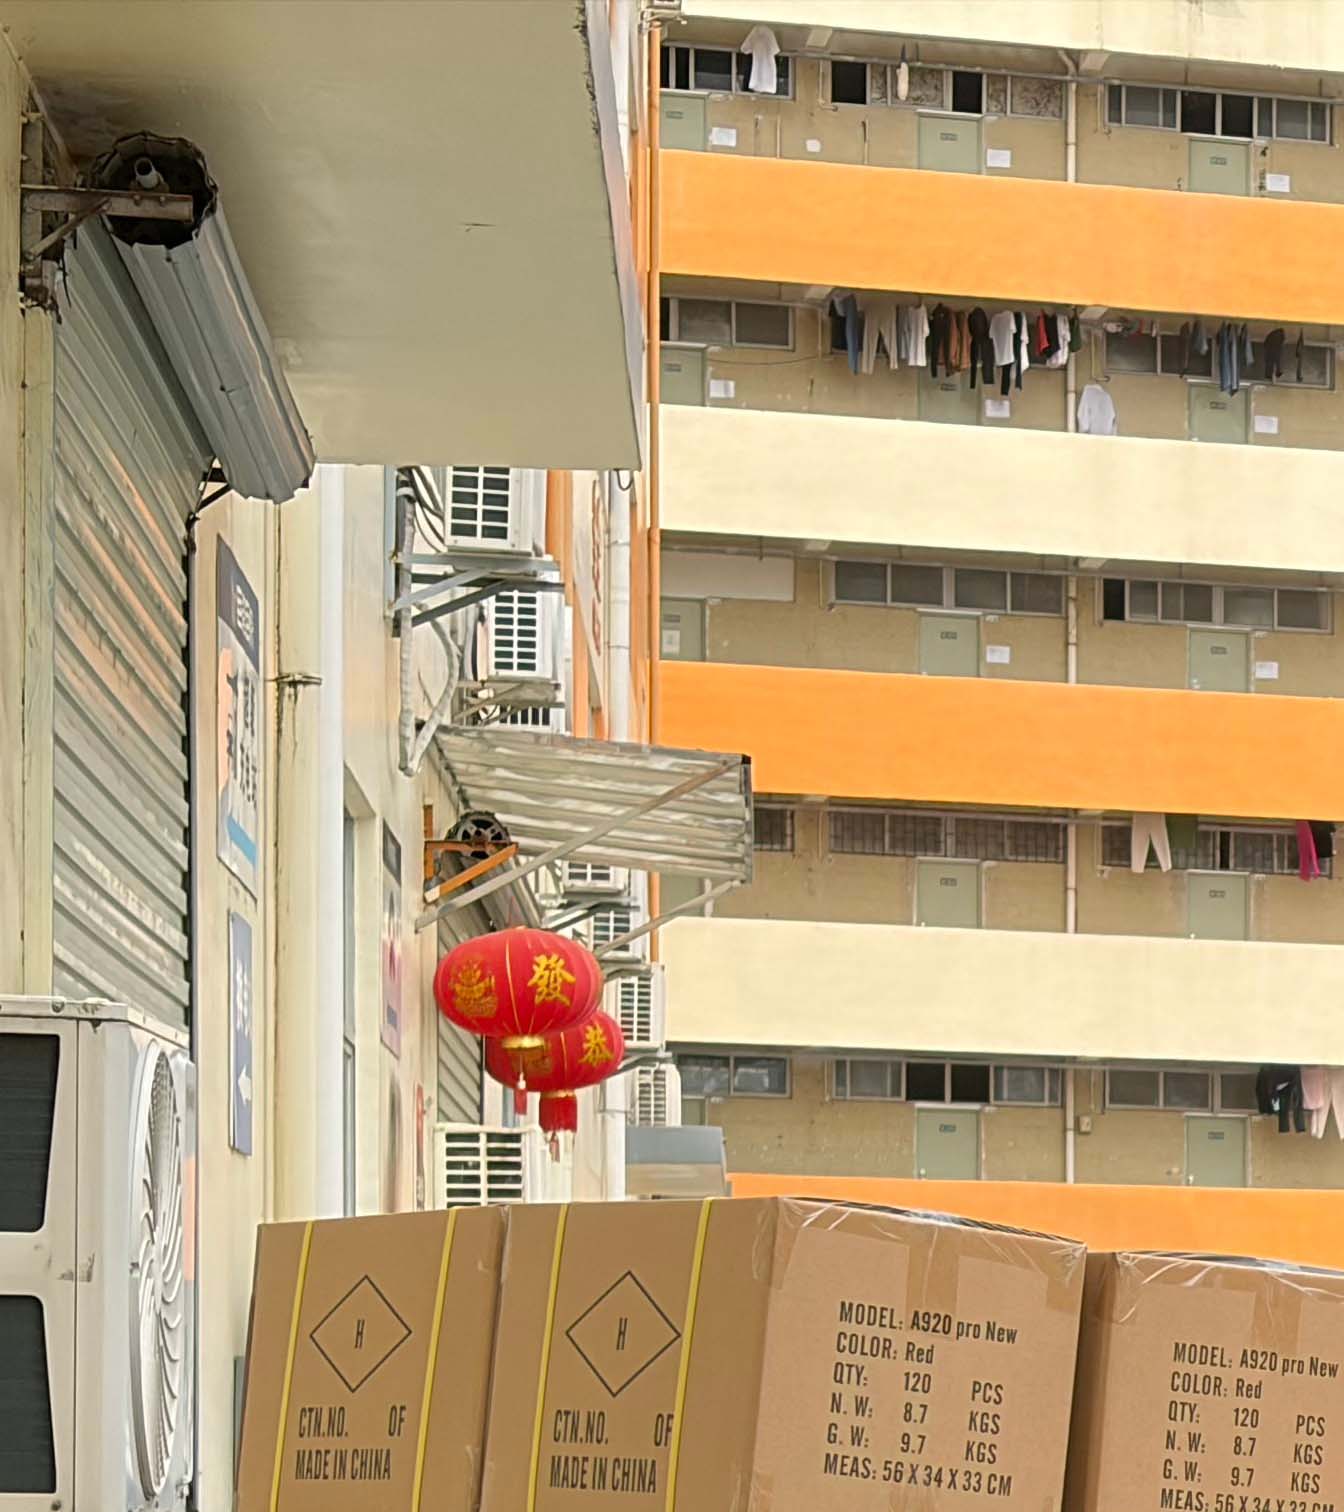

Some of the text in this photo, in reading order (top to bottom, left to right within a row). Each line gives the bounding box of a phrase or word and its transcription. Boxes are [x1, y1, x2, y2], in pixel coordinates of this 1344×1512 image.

[527, 953, 577, 1007] 發
[354, 1319, 365, 1349] H
[616, 1317, 628, 1350] H
[840, 1301, 1017, 1344] MODEL: A920 pro New
[837, 1332, 934, 1364] COLOR: Red
[834, 1362, 1003, 1405] QTY: 120 PCS
[299, 1405, 406, 1438] CTN.NO. OF
[554, 1409, 674, 1447] CTN.NO. OF
[904, 1402, 928, 1424] 8.7
[969, 1411, 1000, 1435] KGS
[295, 1449, 390, 1480] MADE IN CHINA
[901, 1433, 926, 1454] 9.7
[965, 1440, 997, 1464] KGS
[550, 1455, 656, 1493] MADE IN CHINA
[824, 1453, 1012, 1496] MEAS: 56 X 34 X 33 CM
